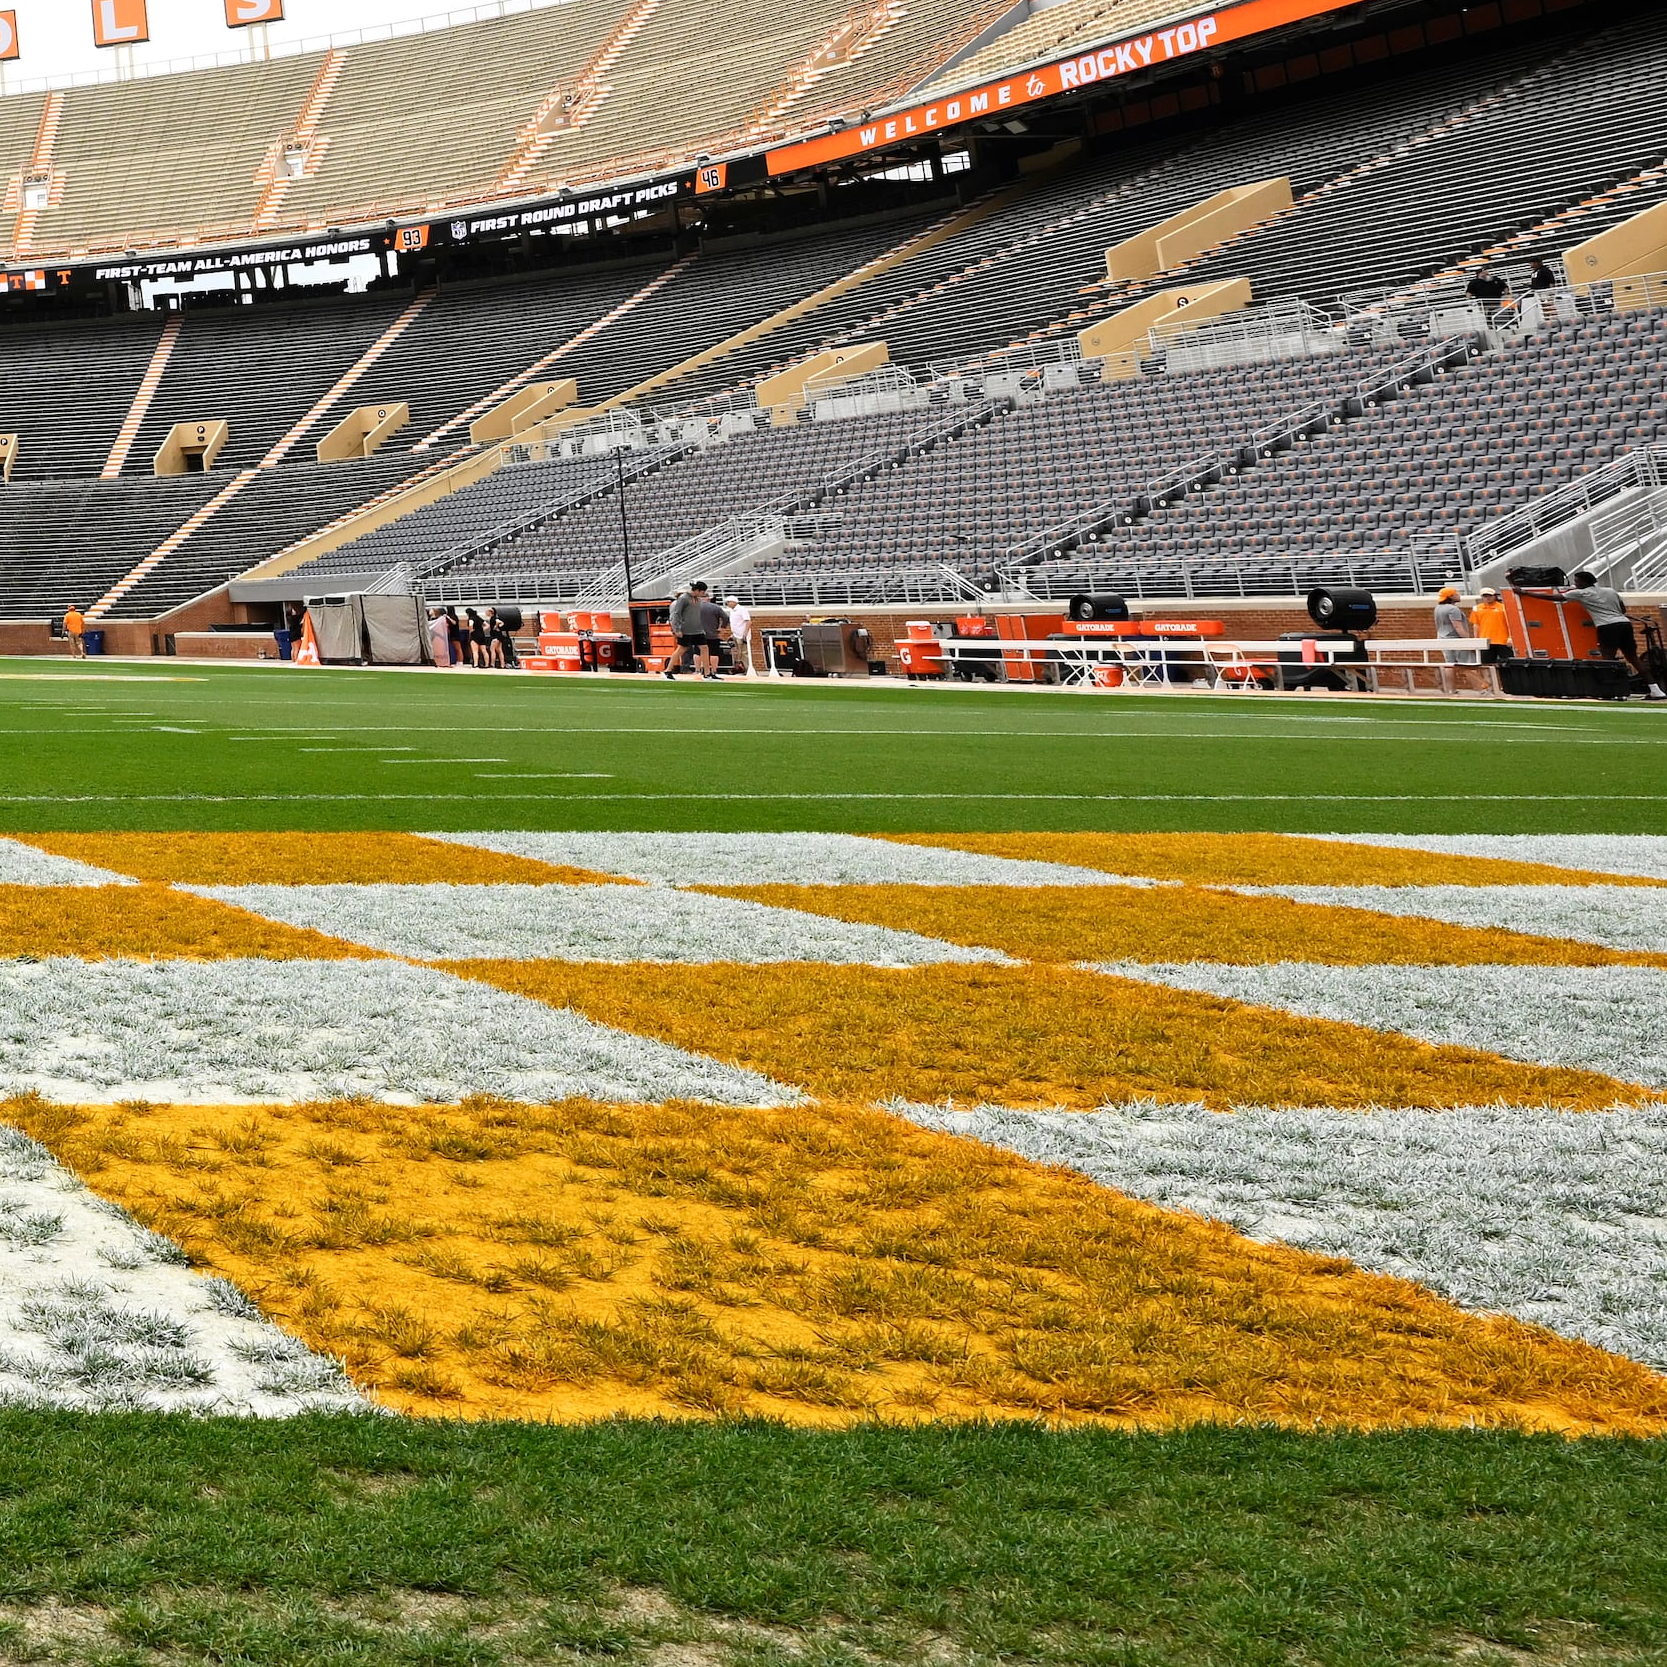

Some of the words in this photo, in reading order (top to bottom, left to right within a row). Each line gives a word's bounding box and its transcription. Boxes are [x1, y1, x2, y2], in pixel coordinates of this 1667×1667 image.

[860, 85, 1011, 147] WELCOME
[1026, 73, 1046, 98] to
[1058, 36, 1156, 89] ROCKY
[1159, 16, 1217, 59] TOP
[702, 169, 720, 189] 46
[470, 214, 518, 235] FIRST
[520, 202, 576, 225] ROUND
[578, 192, 634, 215] DRAFT
[635, 181, 678, 204] PICKS
[402, 229, 423, 247] 93
[56, 270, 71, 286] T
[95, 259, 192, 281] FIRST-TEAM
[194, 248, 303, 272] ALL-AMERICA
[304, 238, 371, 258] HONORS
[1076, 624, 1115, 632] GATORADE
[1155, 624, 1197, 632] GATORADE
[599, 645, 611, 657] G
